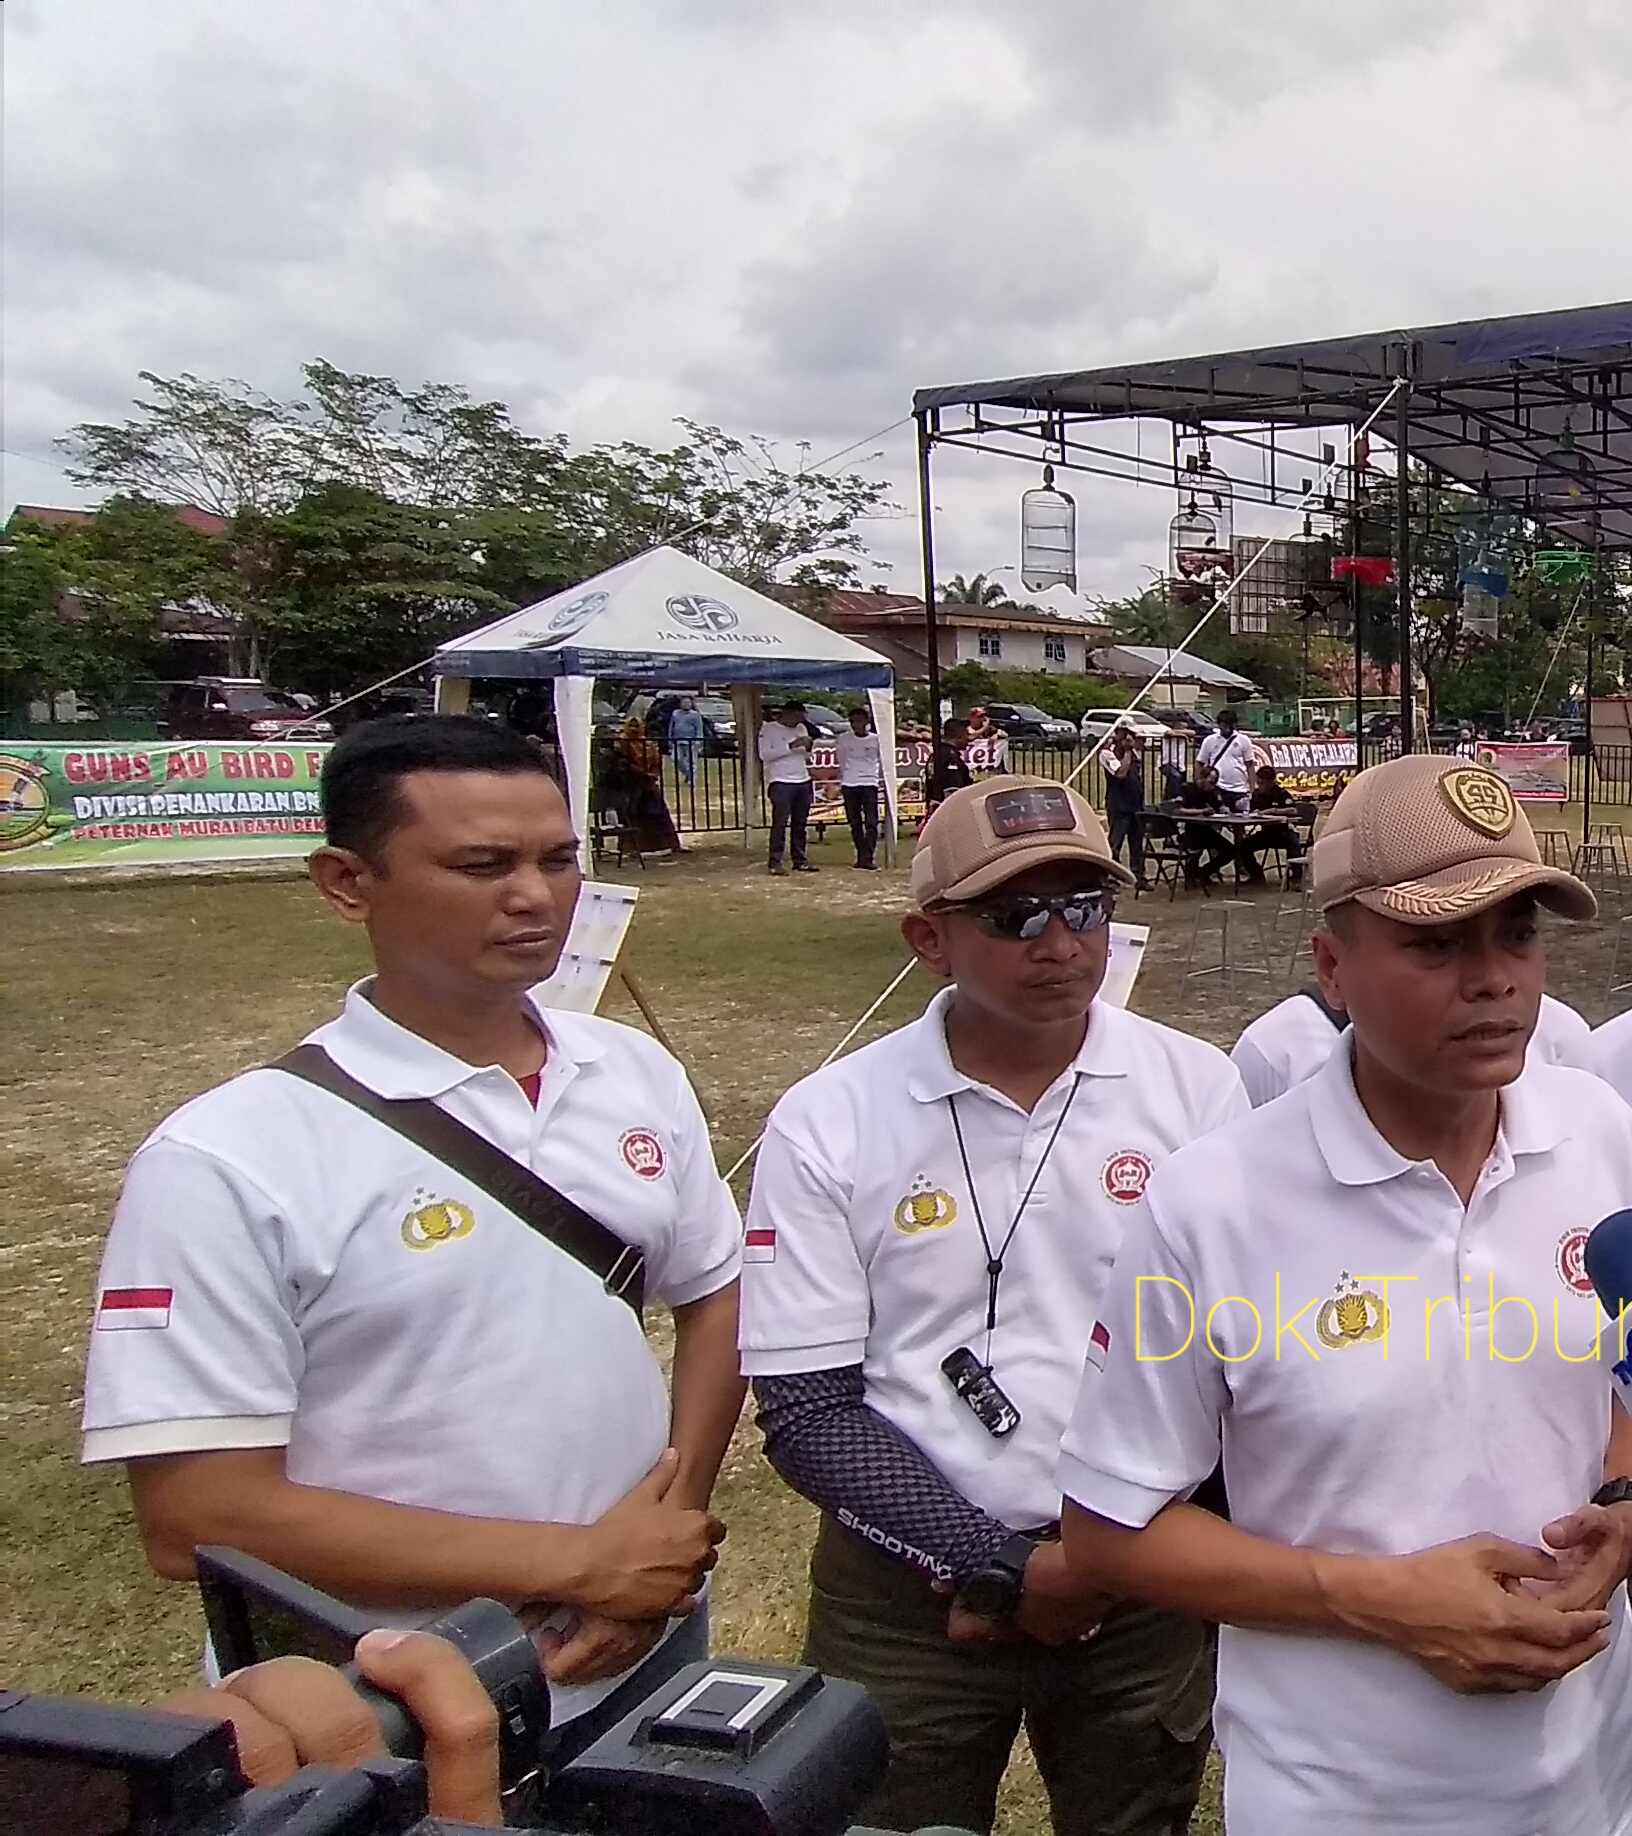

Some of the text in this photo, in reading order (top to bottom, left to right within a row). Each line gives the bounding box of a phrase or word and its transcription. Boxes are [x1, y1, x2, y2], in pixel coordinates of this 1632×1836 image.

[657, 630, 702, 641] JASA
[64, 751, 152, 783] GUNS
[166, 751, 209, 780] AU
[219, 751, 295, 779] BIRD
[1291, 744, 1312, 767] DPC
[73, 796, 146, 819] DIVISI
[71, 821, 173, 840] PETERNAK
[179, 819, 239, 836] MURAI
[241, 818, 290, 834] BATU
[837, 1507, 952, 1580] SHOOTING
